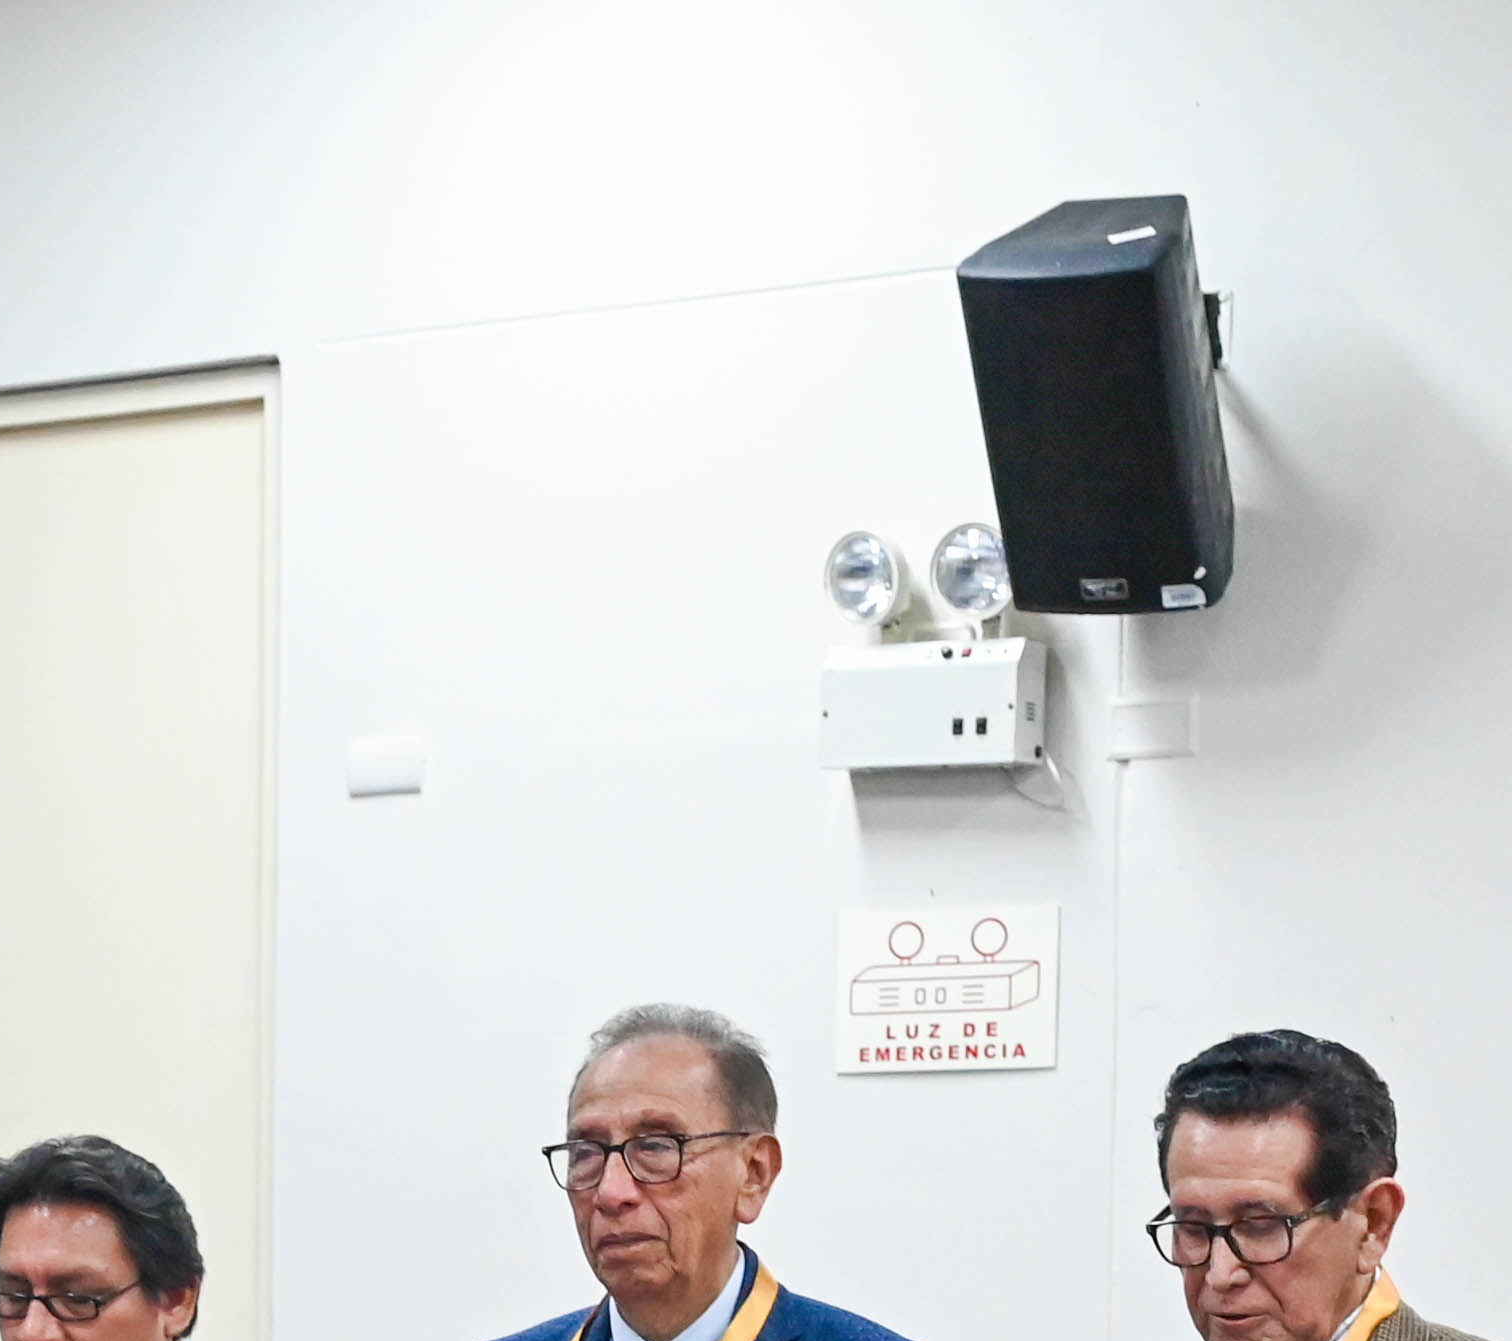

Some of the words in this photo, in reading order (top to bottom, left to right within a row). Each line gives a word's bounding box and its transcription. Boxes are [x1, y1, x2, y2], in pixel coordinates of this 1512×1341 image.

[886, 1023, 941, 1040] LUZ
[963, 1022, 998, 1038] DE
[859, 1043, 1027, 1063] EMERGENCIA
